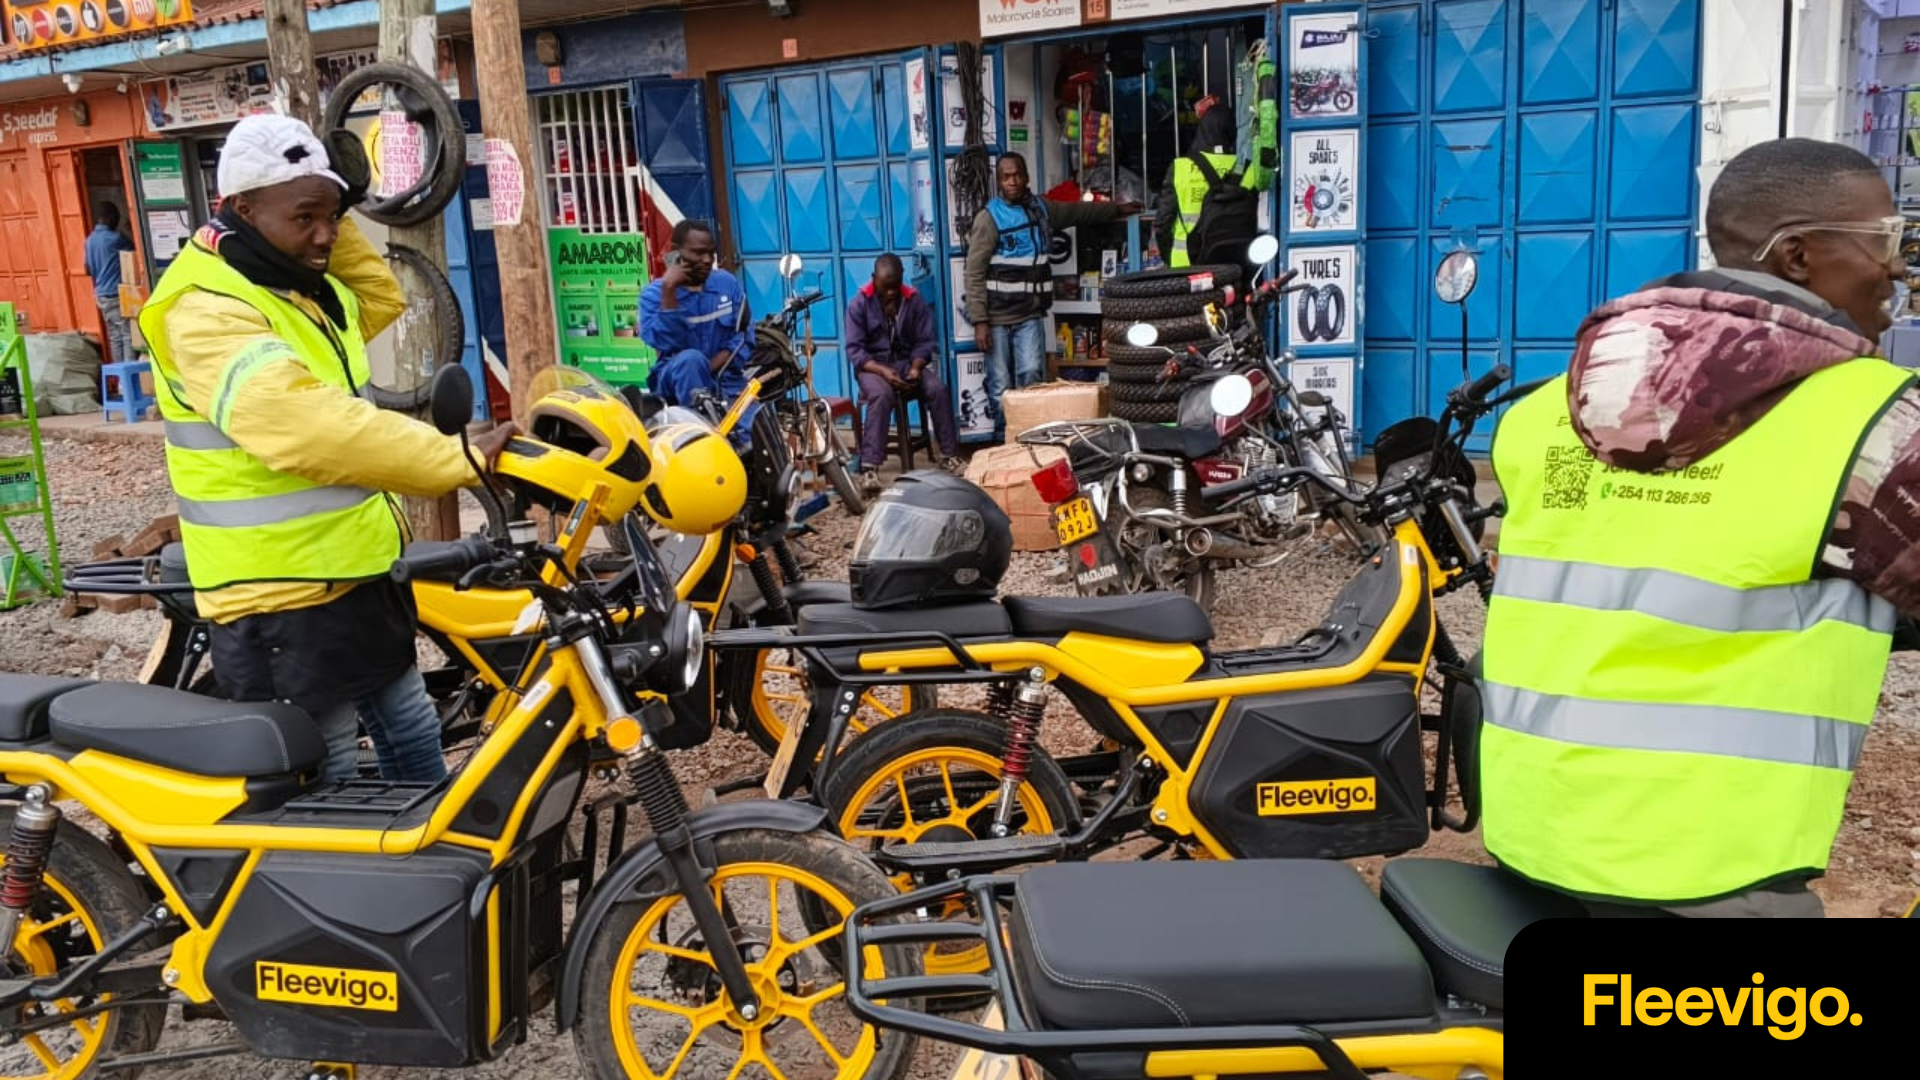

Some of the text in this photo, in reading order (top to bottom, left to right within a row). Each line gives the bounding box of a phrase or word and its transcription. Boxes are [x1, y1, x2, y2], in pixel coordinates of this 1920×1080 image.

[986, 9, 1041, 24] Motorcycle
[1042, 5, 1075, 18] Spares
[3, 106, 58, 136] Speedaf
[1316, 138, 1332, 151] ALL
[1309, 150, 1339, 165] SPARES
[558, 241, 643, 265] AMARON
[1302, 257, 1341, 280] TYRES
[1611, 485, 1643, 500] +254
[1060, 516, 1093, 541] 092J
[1259, 781, 1374, 810] Fleevigo.
[259, 965, 395, 1006] Fleevigo.
